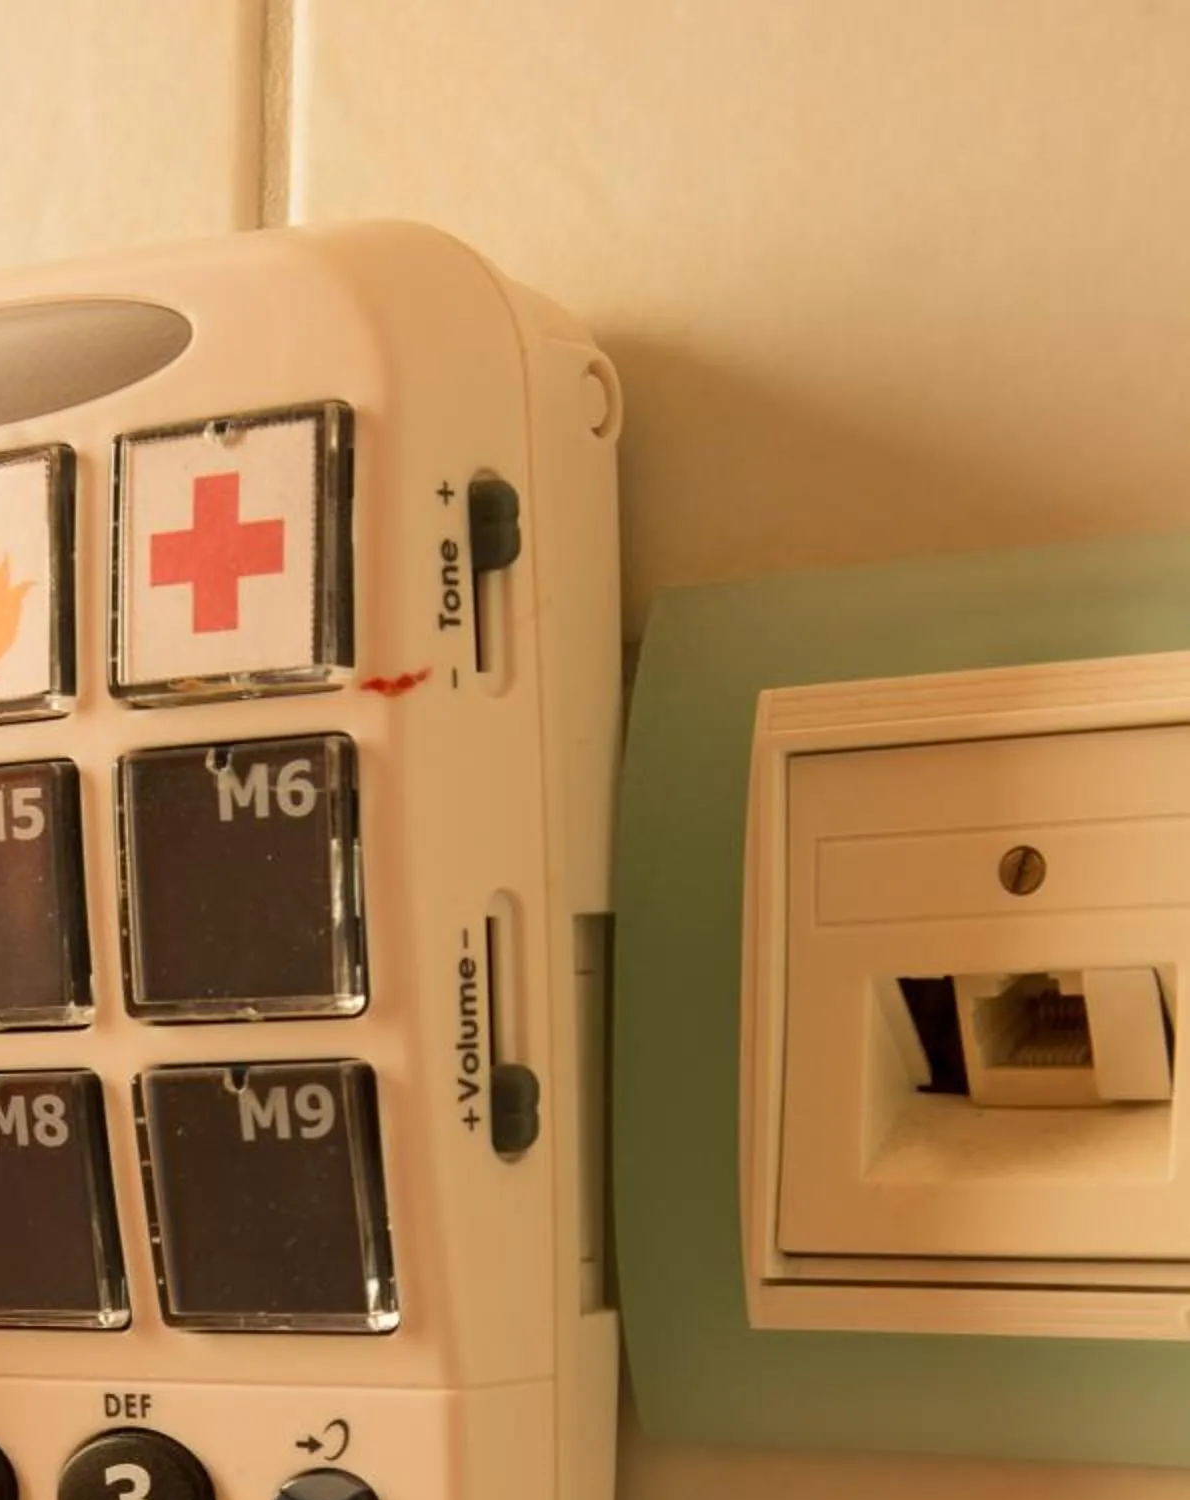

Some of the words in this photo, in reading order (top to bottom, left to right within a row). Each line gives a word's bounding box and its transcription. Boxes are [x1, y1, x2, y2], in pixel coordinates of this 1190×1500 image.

[438, 538, 462, 631] Tone
[216, 759, 318, 822] M6
[455, 956, 481, 1103] Volume
[236, 1083, 336, 1143] M9
[103, 1392, 152, 1419] DEF
